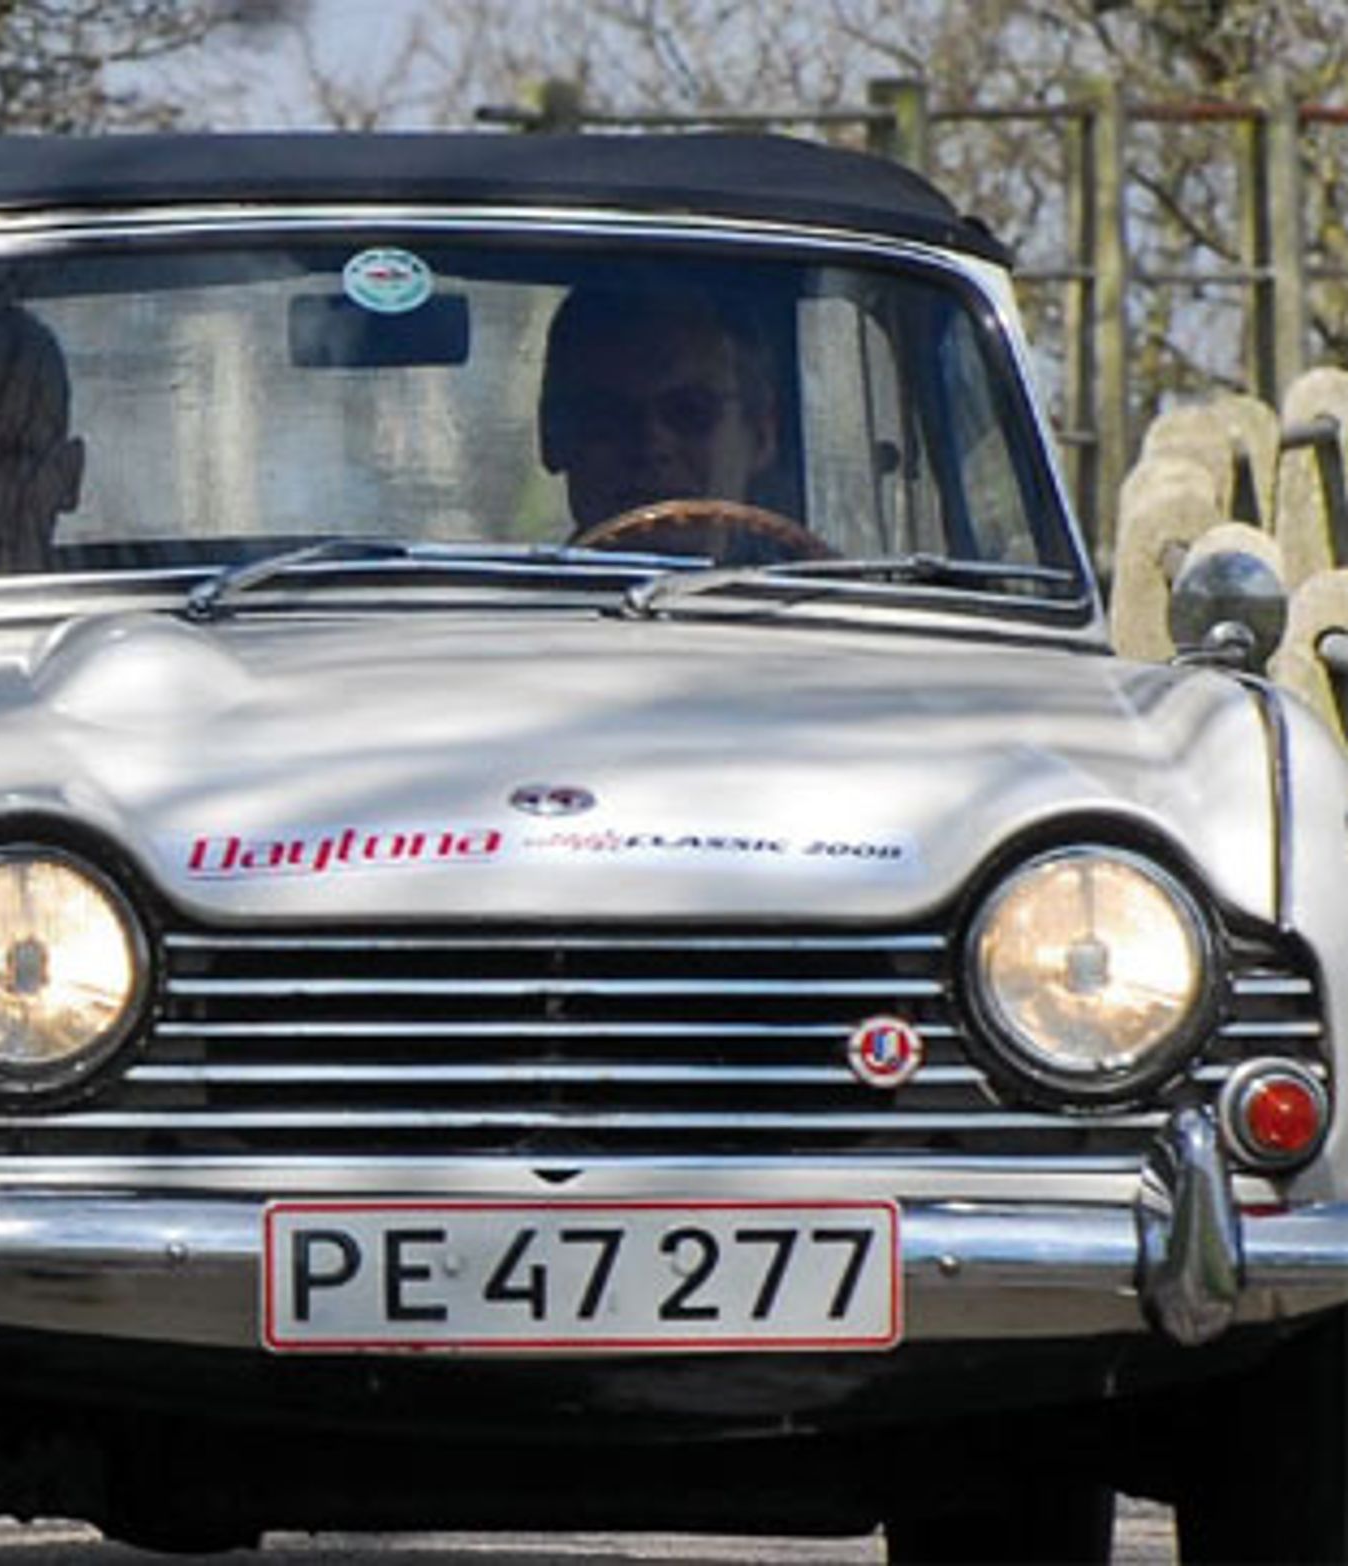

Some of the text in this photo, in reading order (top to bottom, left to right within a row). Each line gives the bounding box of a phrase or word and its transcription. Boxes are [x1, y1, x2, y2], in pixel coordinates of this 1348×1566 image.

[187, 827, 501, 873] Daytona
[625, 833, 789, 852] CLASSIC
[291, 1228, 875, 1322] PE 47 277
